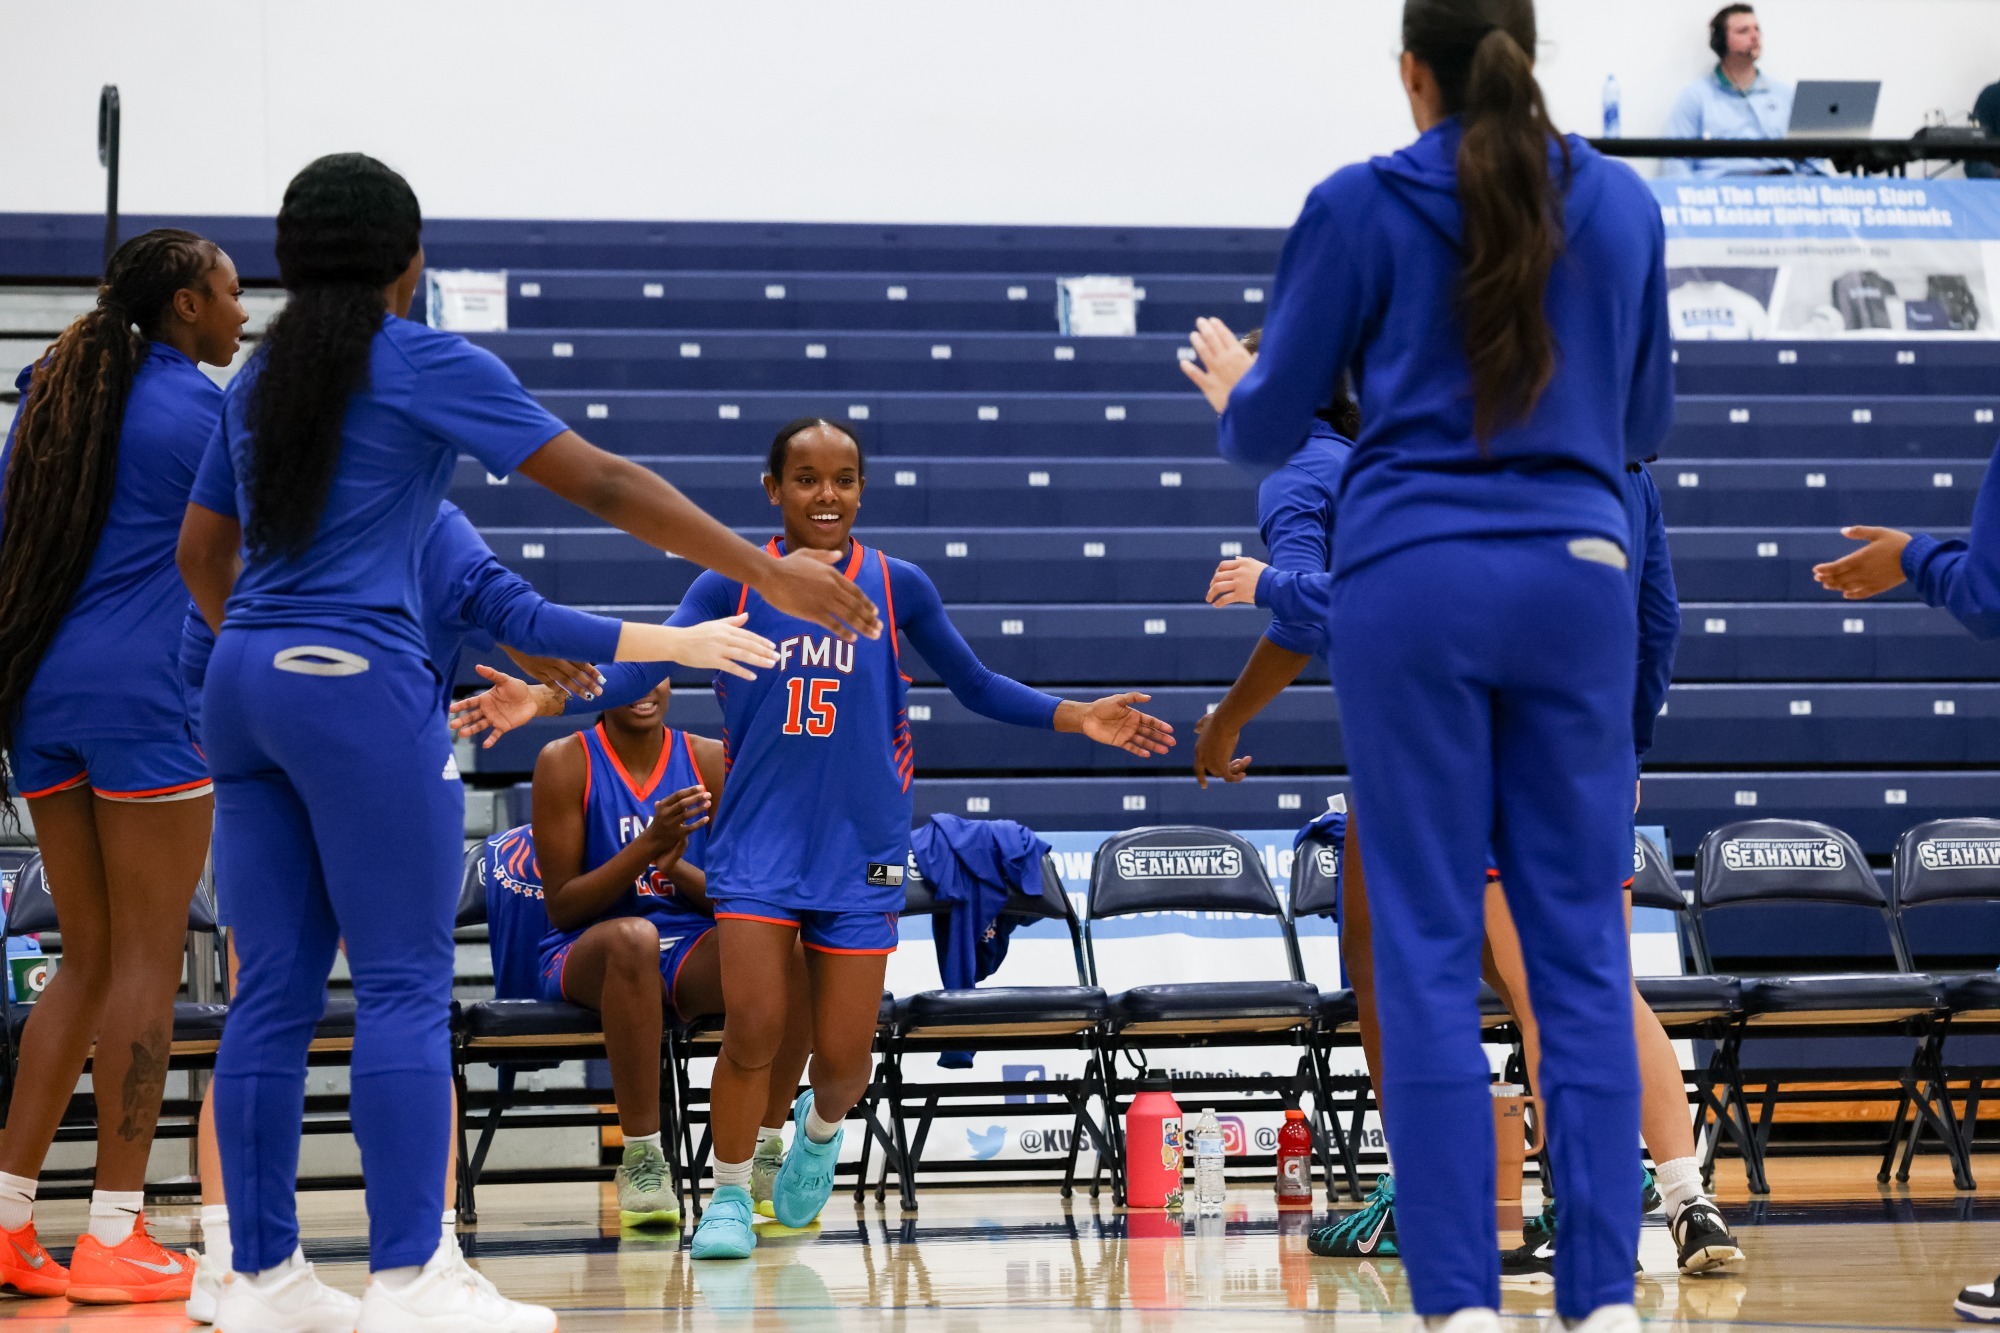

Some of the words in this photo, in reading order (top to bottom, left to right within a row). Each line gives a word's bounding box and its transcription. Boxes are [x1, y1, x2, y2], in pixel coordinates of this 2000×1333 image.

[1677, 186, 1719, 205] Visit
[1720, 186, 1754, 205] The
[1756, 185, 1818, 205] Official
[1821, 185, 1877, 206] Online
[1878, 186, 1926, 206] Store
[1680, 206, 1713, 225] The
[1714, 207, 1770, 225] Keiser
[1773, 207, 1860, 228] University
[1863, 207, 1952, 227] Seahawks
[780, 635, 855, 673] FMU
[782, 677, 840, 737] 15
[619, 815, 655, 844] FM
[1119, 851, 1238, 876] SEAHAWKS
[1135, 850, 1167, 858] KEISER
[1168, 849, 1222, 858] UNIVERSITY
[1725, 844, 1841, 867] SEAHAWKS
[1284, 1159, 1300, 1178] G
